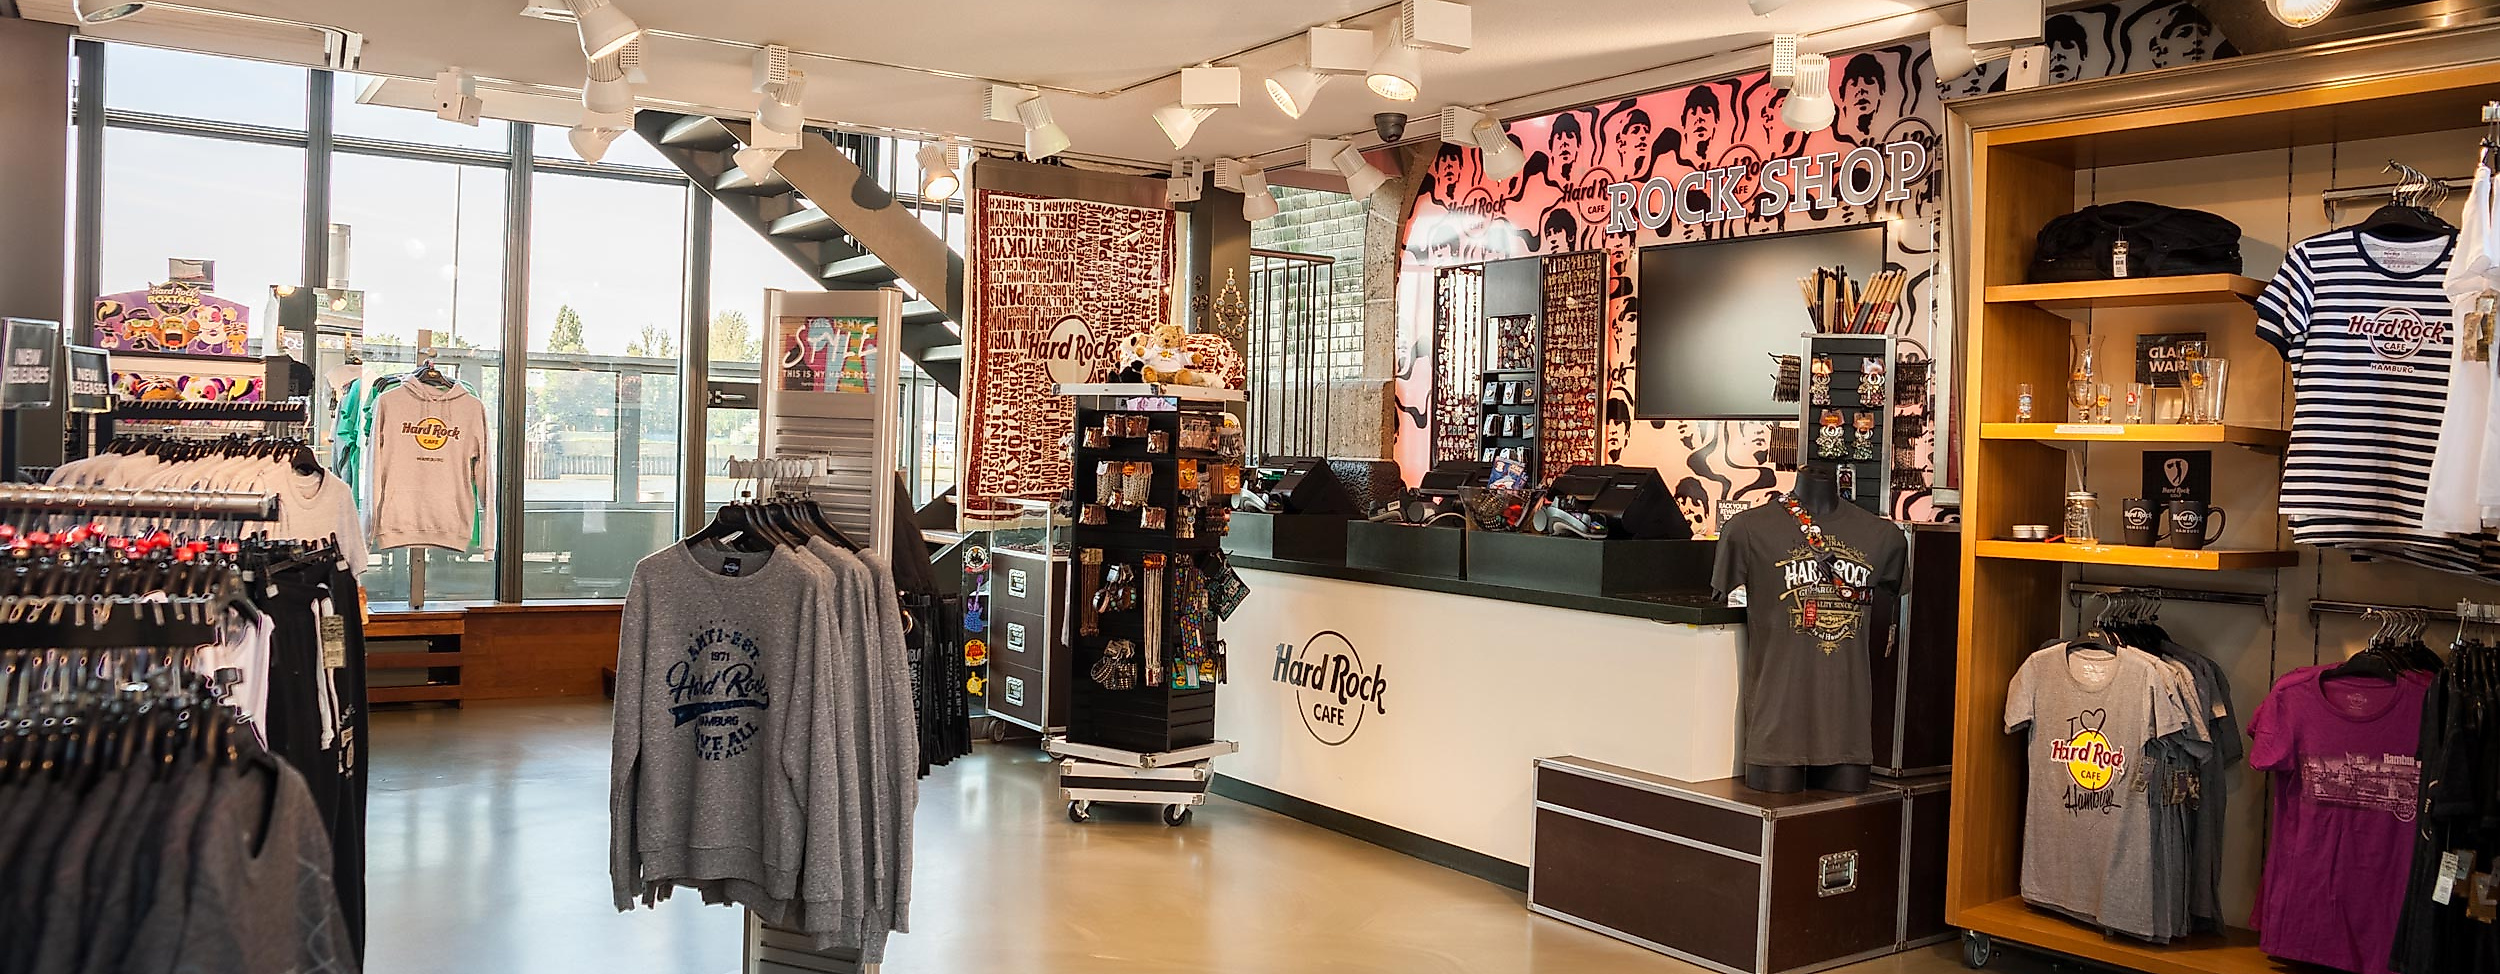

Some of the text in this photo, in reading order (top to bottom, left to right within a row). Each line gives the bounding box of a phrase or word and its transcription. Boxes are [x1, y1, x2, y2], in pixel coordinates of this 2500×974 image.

[1563, 180, 1598, 204] Hard
[1607, 166, 1746, 234] ROCK
[1760, 141, 1927, 217] SHOP
[1732, 185, 1749, 195] AFE
[990, 198, 1078, 212] SHARM EL SHEIKH
[1479, 194, 1506, 219] Rock
[1588, 204, 1606, 215] CAFE
[1023, 212, 1077, 229] BERLIN
[1086, 204, 1101, 234] ROME
[990, 228, 1042, 237] BANGKOK
[1099, 205, 1115, 260] PARIS
[1143, 210, 1156, 261] MOSCOW
[990, 238, 1034, 259] TOKYO
[1034, 239, 1075, 252] SYDNEY
[1035, 252, 1075, 260] LONDON
[1076, 236, 1085, 266] NEW
[1126, 209, 1141, 281] TOKYO
[147, 295, 201, 307] ROXTARS
[152, 285, 201, 299] Hard Rock
[990, 284, 1024, 307] PARIS
[1025, 297, 1074, 306] HOLLYWOOD
[1095, 264, 1104, 338] OLLYWOOD
[1141, 264, 1152, 334] ERLIN
[1101, 296, 1109, 336] ORENCE
[1128, 280, 1136, 337] YDNEY
[807, 319, 862, 329] THIS IS MY
[1110, 302, 1123, 339] ENICE
[2348, 315, 2445, 343] Hard Rock
[15, 348, 42, 366] NEW
[782, 322, 878, 369] STYLE
[1028, 333, 1117, 367] Hard Rock
[2383, 342, 2407, 351] CAFE
[6, 367, 50, 384] RELEASES
[75, 367, 99, 382] NEW
[783, 370, 800, 378] THIS
[803, 370, 812, 378] IS
[814, 370, 825, 378] MY
[2370, 363, 2414, 374] HAMBURG
[71, 382, 108, 395] RELEASES
[1010, 352, 1019, 423] SYDNEY
[1023, 362, 1035, 400] ENICE
[1044, 400, 1060, 426] FIJI
[401, 422, 460, 440] Hard Rock
[987, 442, 1000, 494] MOSCOW
[1004, 422, 1022, 494] TOKYO
[1026, 439, 1042, 492] PARIS
[1042, 464, 1060, 490] ROME
[2176, 487, 2190, 495] Rock
[2124, 510, 2153, 519] Hard Rock
[2172, 513, 2188, 521] Hard
[1784, 560, 1823, 590] HAR
[711, 651, 730, 661] 1971
[1272, 643, 1387, 715] Hard Rock
[700, 716, 739, 726] AMBURG
[1313, 703, 1345, 726] CAFE
[728, 722, 759, 748] ALL
[2066, 716, 2078, 742] I
[2051, 739, 2092, 761] Hard
[2080, 769, 2101, 781] CAFE
[2063, 781, 2122, 818] Hamburg
